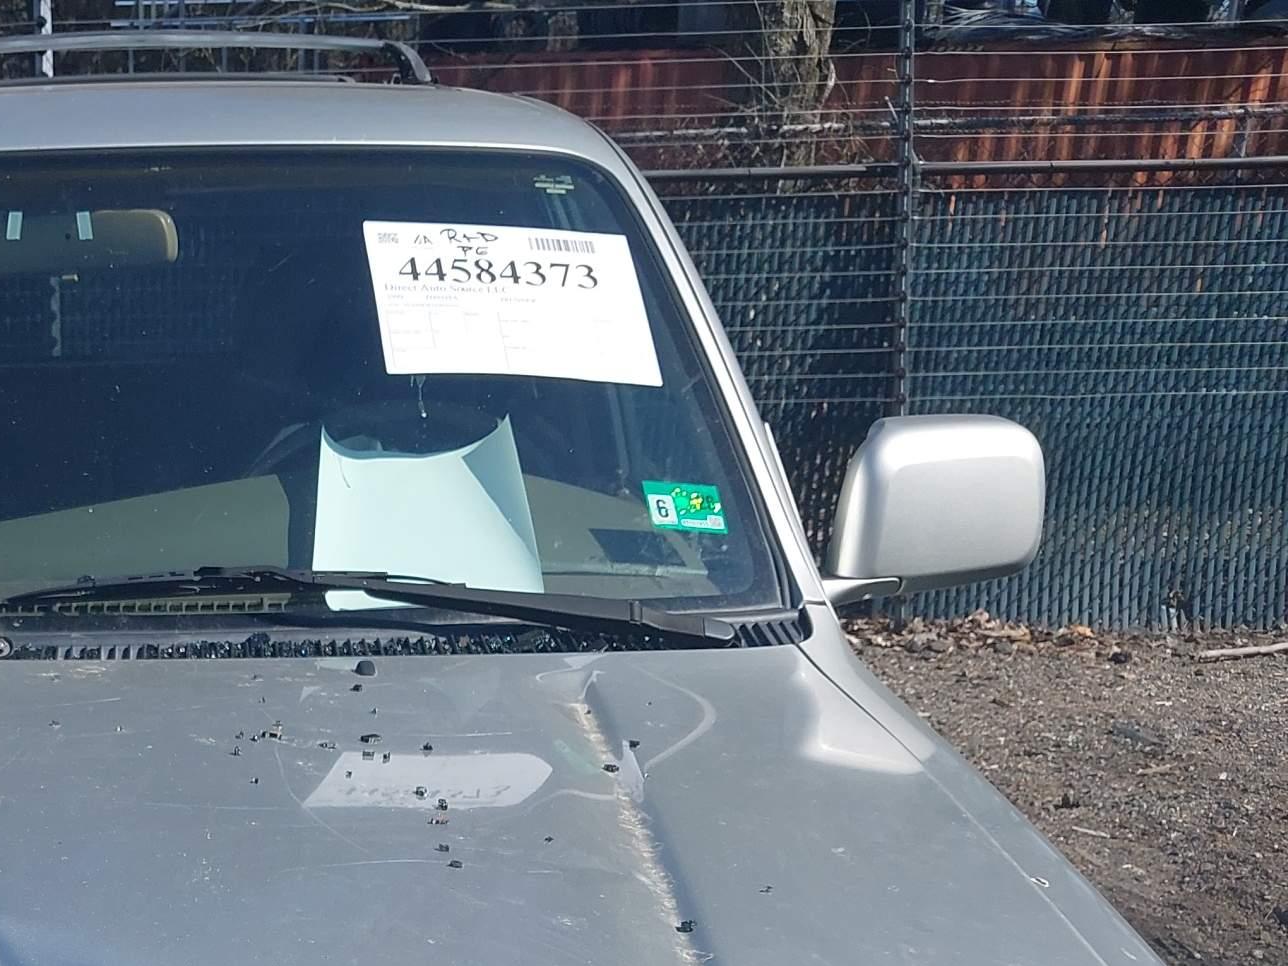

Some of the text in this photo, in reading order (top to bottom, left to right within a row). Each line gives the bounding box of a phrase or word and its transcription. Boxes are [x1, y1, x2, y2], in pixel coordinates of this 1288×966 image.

[399, 257, 598, 289] 44584373
[384, 282, 417, 292] Direct
[420, 283, 446, 293] Auto
[449, 284, 484, 293] Source
[655, 499, 669, 518] 6
